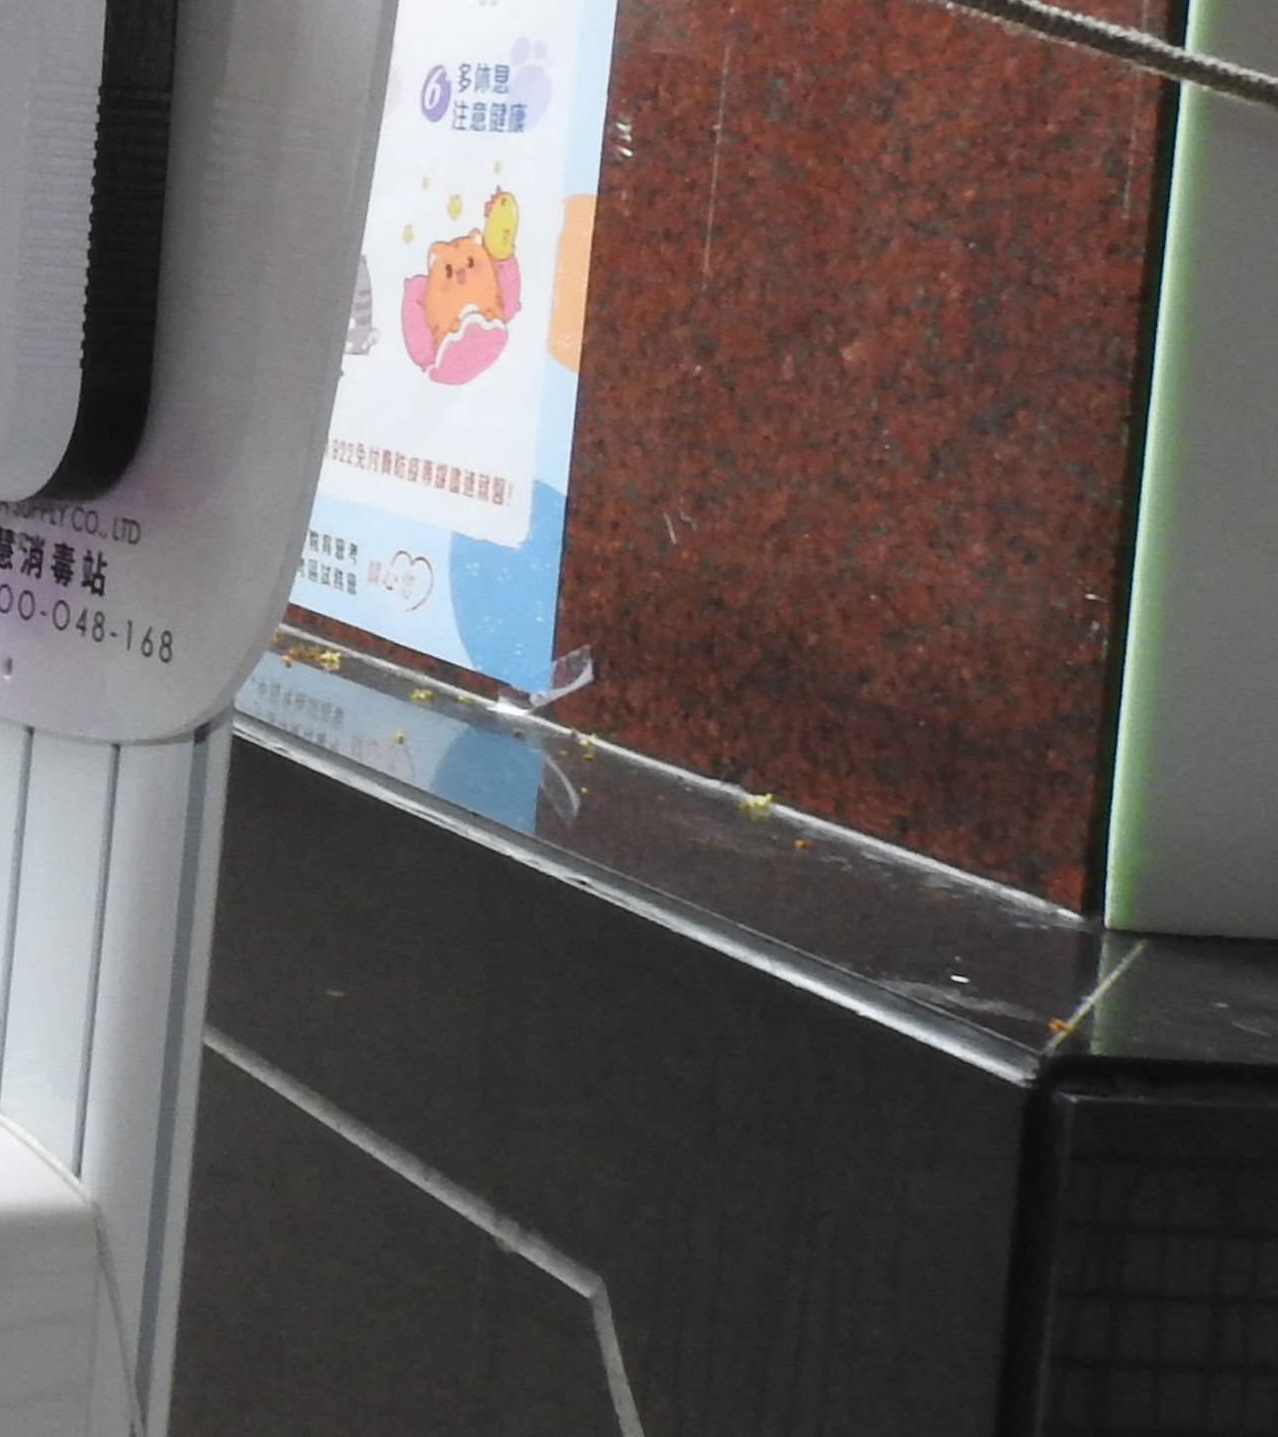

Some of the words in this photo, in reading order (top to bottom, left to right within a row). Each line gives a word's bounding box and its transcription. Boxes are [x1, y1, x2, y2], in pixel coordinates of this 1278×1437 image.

[457, 63, 509, 94] 多休息
[451, 100, 527, 133] 注意健康
